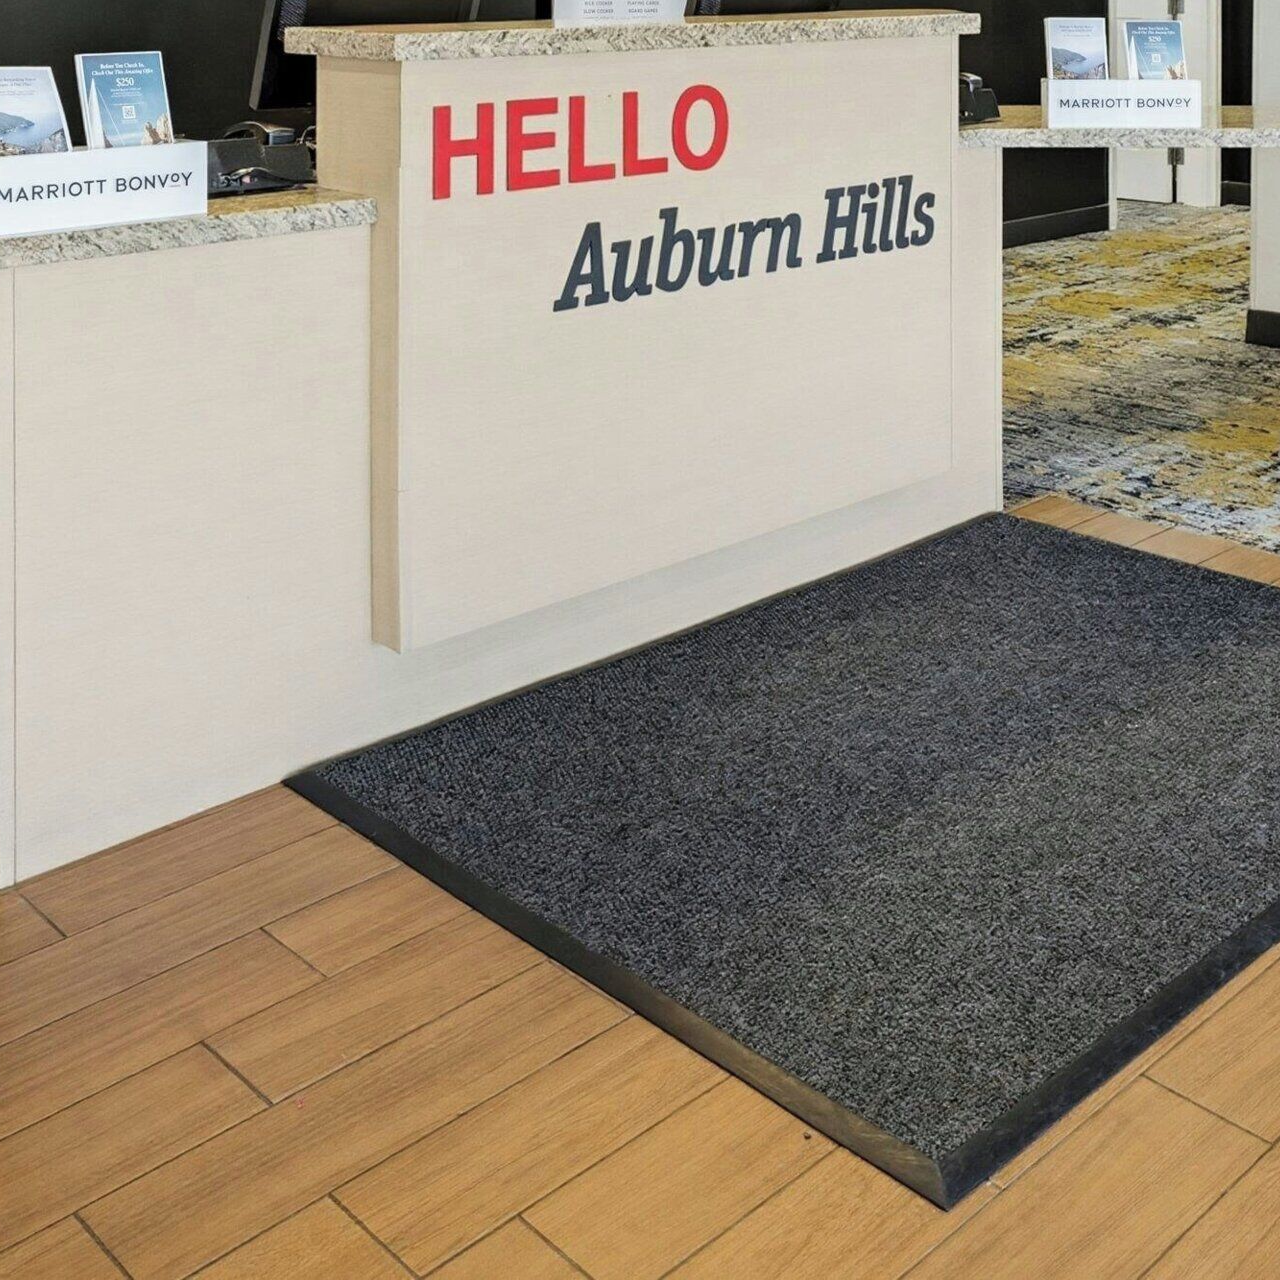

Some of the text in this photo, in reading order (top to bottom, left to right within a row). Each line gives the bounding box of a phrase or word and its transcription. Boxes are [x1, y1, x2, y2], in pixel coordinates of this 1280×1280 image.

[1059, 97, 1192, 109] MARRIOTT BONVOY
[431, 83, 730, 200] HELLO
[115, 171, 193, 194] BONVOY
[552, 174, 936, 313] Auburn Hills
